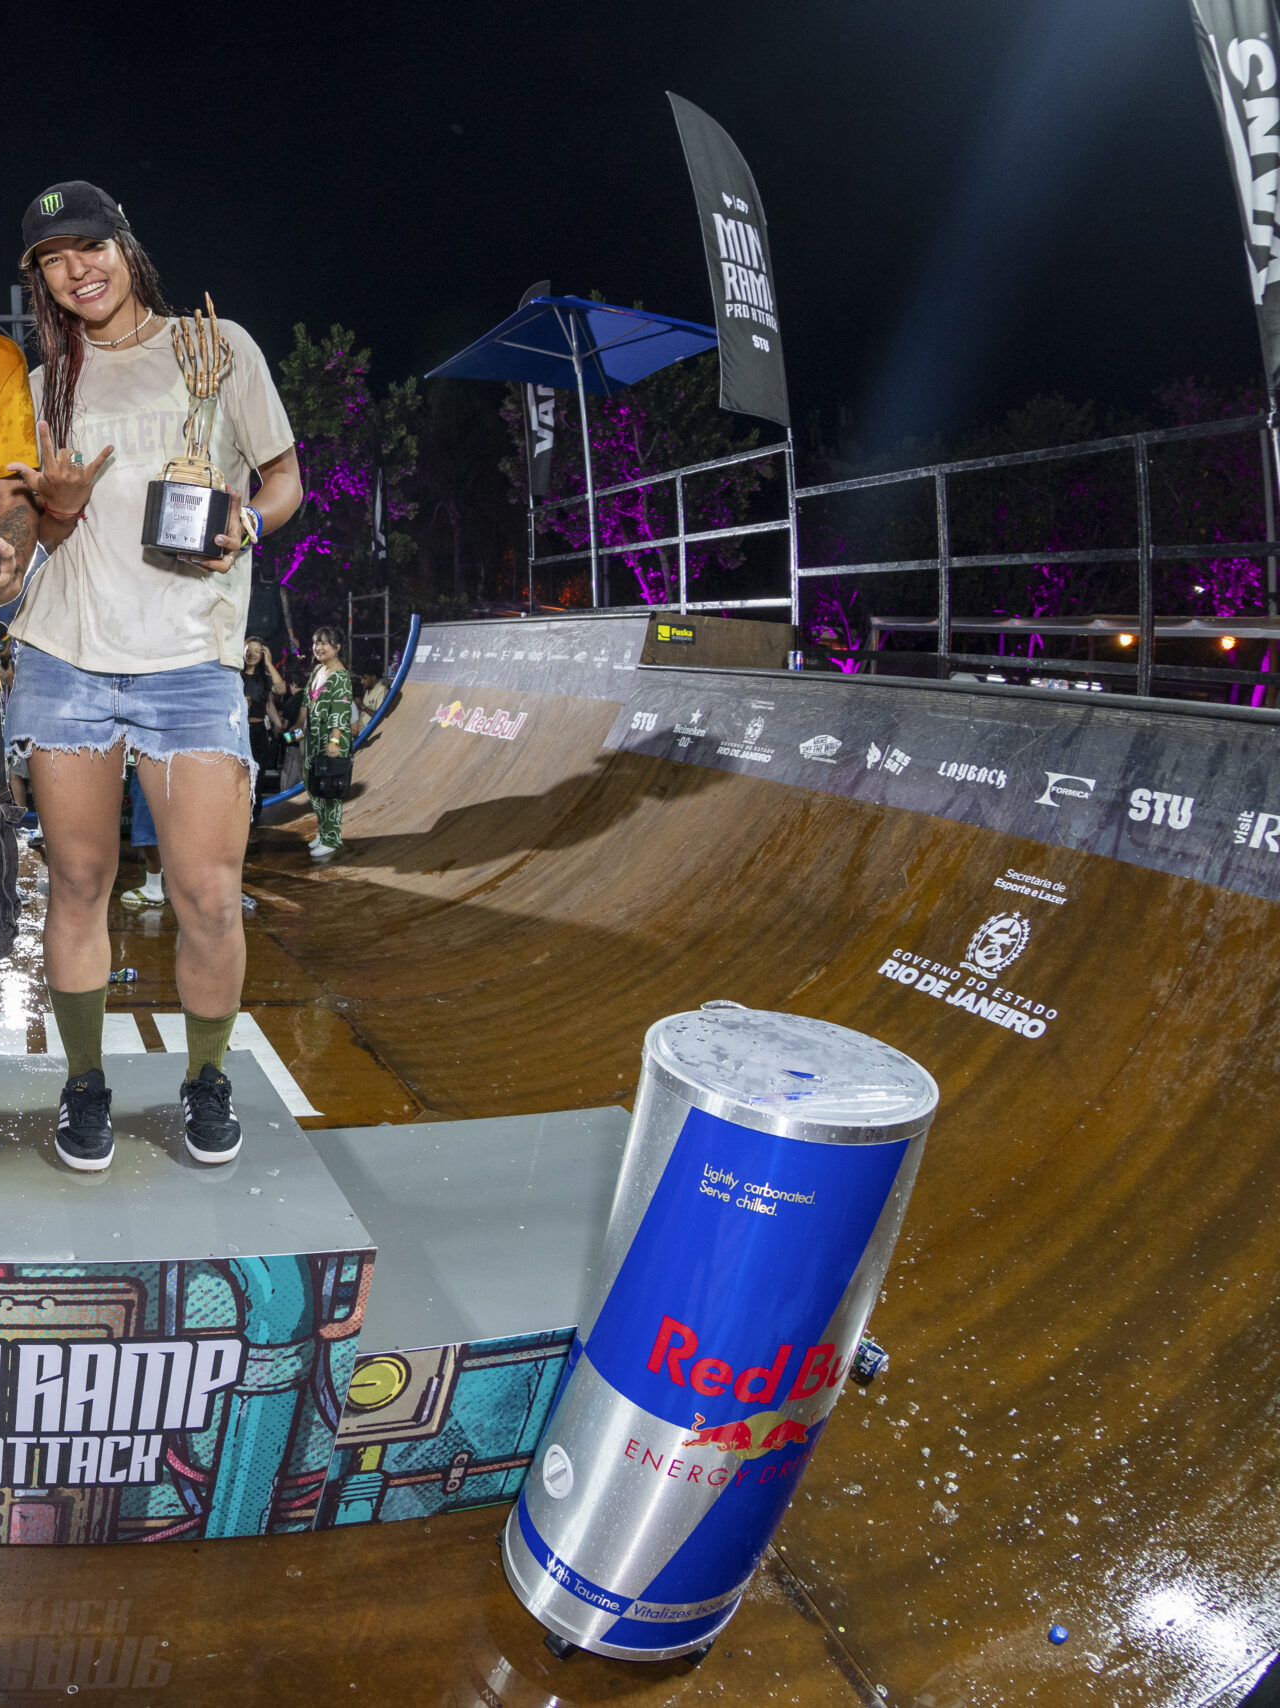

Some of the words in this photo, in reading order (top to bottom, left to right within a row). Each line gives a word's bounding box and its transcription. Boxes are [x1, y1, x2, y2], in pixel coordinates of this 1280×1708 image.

[713, 213, 766, 274] MIN
[725, 303, 751, 319] PRO
[752, 334, 770, 353] STU
[671, 627, 693, 637] Fuska
[464, 706, 501, 734] Red
[488, 709, 528, 740] Bull
[631, 711, 658, 732] STU
[673, 723, 707, 737] Heineken
[716, 746, 730, 756] RIO
[729, 748, 741, 758] DE
[740, 750, 771, 763] JANEIRO
[937, 761, 1009, 789] LAYBACK
[1051, 785, 1091, 799] FORMICA
[1128, 788, 1194, 830] STU
[1233, 810, 1255, 844] visit
[993, 877, 1031, 895] Esporte
[1031, 889, 1039, 898] e
[1038, 890, 1068, 905] Lazer
[1005, 868, 1052, 889] Secretaria
[1052, 882, 1066, 893] de
[877, 958, 919, 985] RIO
[914, 973, 952, 998] DE
[945, 987, 1047, 1039] JANEIRO
[892, 948, 961, 981] GOVERNO
[965, 976, 988, 991] DO
[992, 987, 1058, 1020] ESTADO
[699, 1179, 731, 1203] Serve
[736, 1194, 778, 1217] chilled.
[703, 1162, 739, 1191] Lightly
[743, 1182, 816, 1205] carbonated.
[646, 1313, 794, 1404] Red
[786, 1343, 851, 1402] Bu
[19, 1338, 243, 1432] RAMP
[624, 1438, 751, 1487] ENERGY
[574, 1579, 621, 1612] Taurine.
[633, 1603, 692, 1621] Vitalizes
